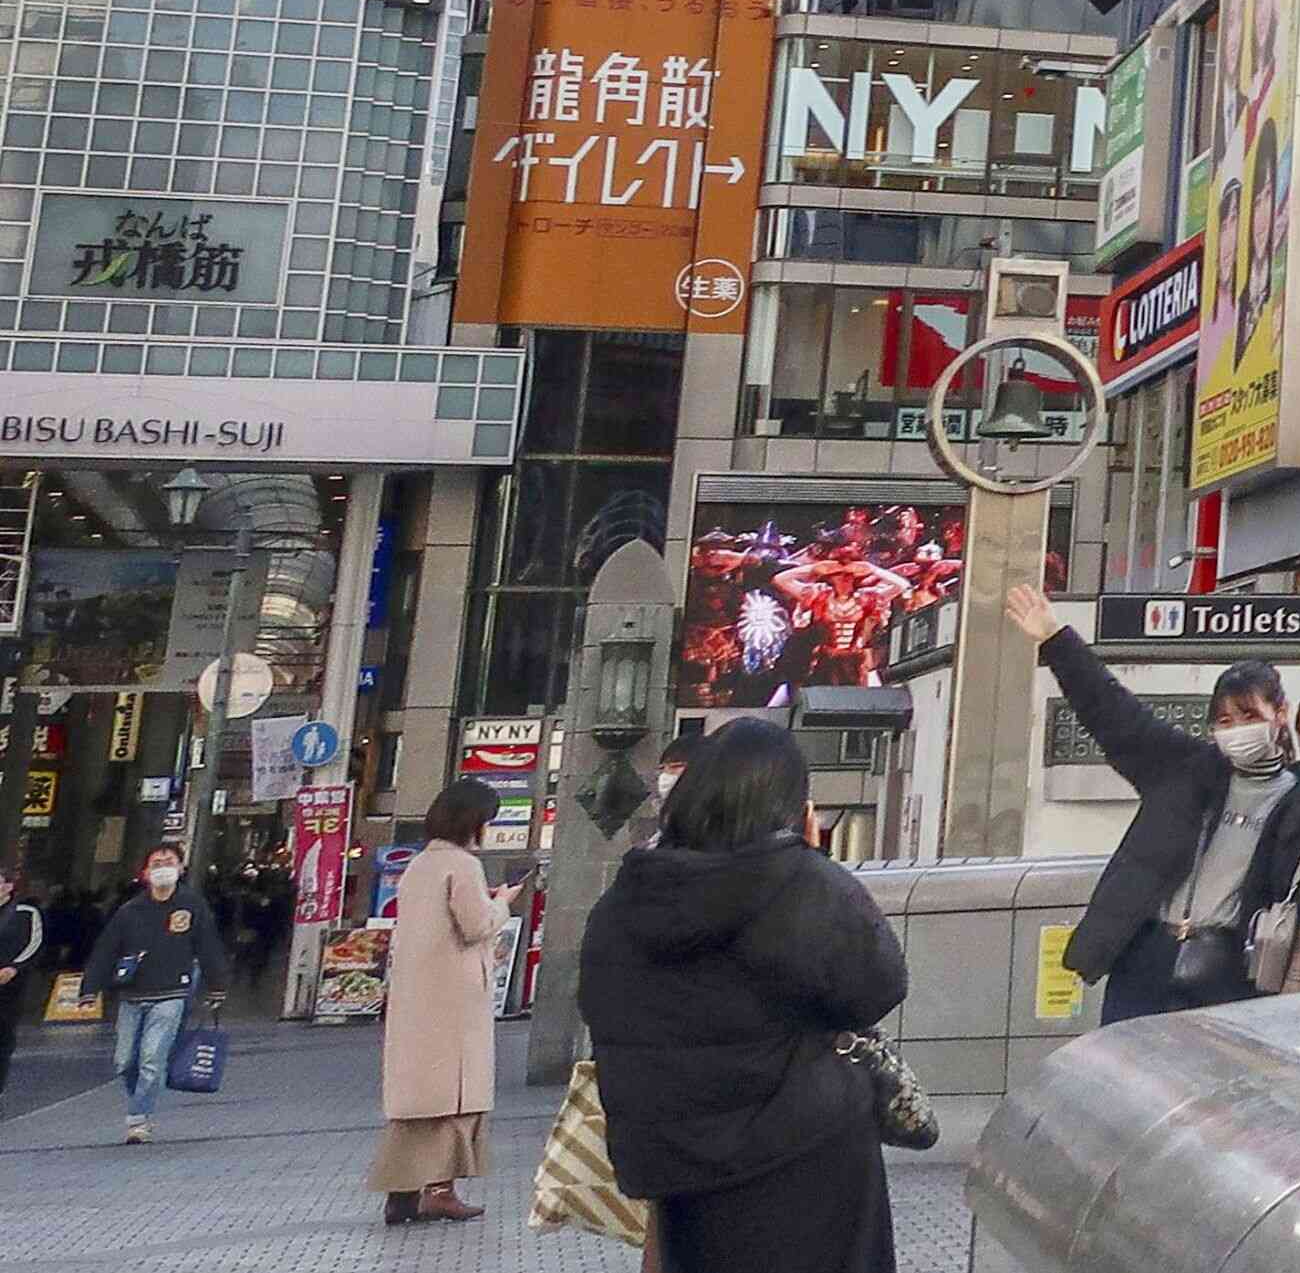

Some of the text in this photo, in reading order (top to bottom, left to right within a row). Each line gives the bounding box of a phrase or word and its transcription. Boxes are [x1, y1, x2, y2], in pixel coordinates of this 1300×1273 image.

[529, 47, 720, 130] 龍角散
[784, 68, 980, 164] NY
[494, 133, 704, 210] ダイレクト
[116, 210, 214, 242] なんば
[70, 242, 245, 292] 戎橋筋
[679, 275, 740, 302] 生薬
[1129, 260, 1199, 345] LOTTERIA
[1191, 604, 1300, 635] Toilets
